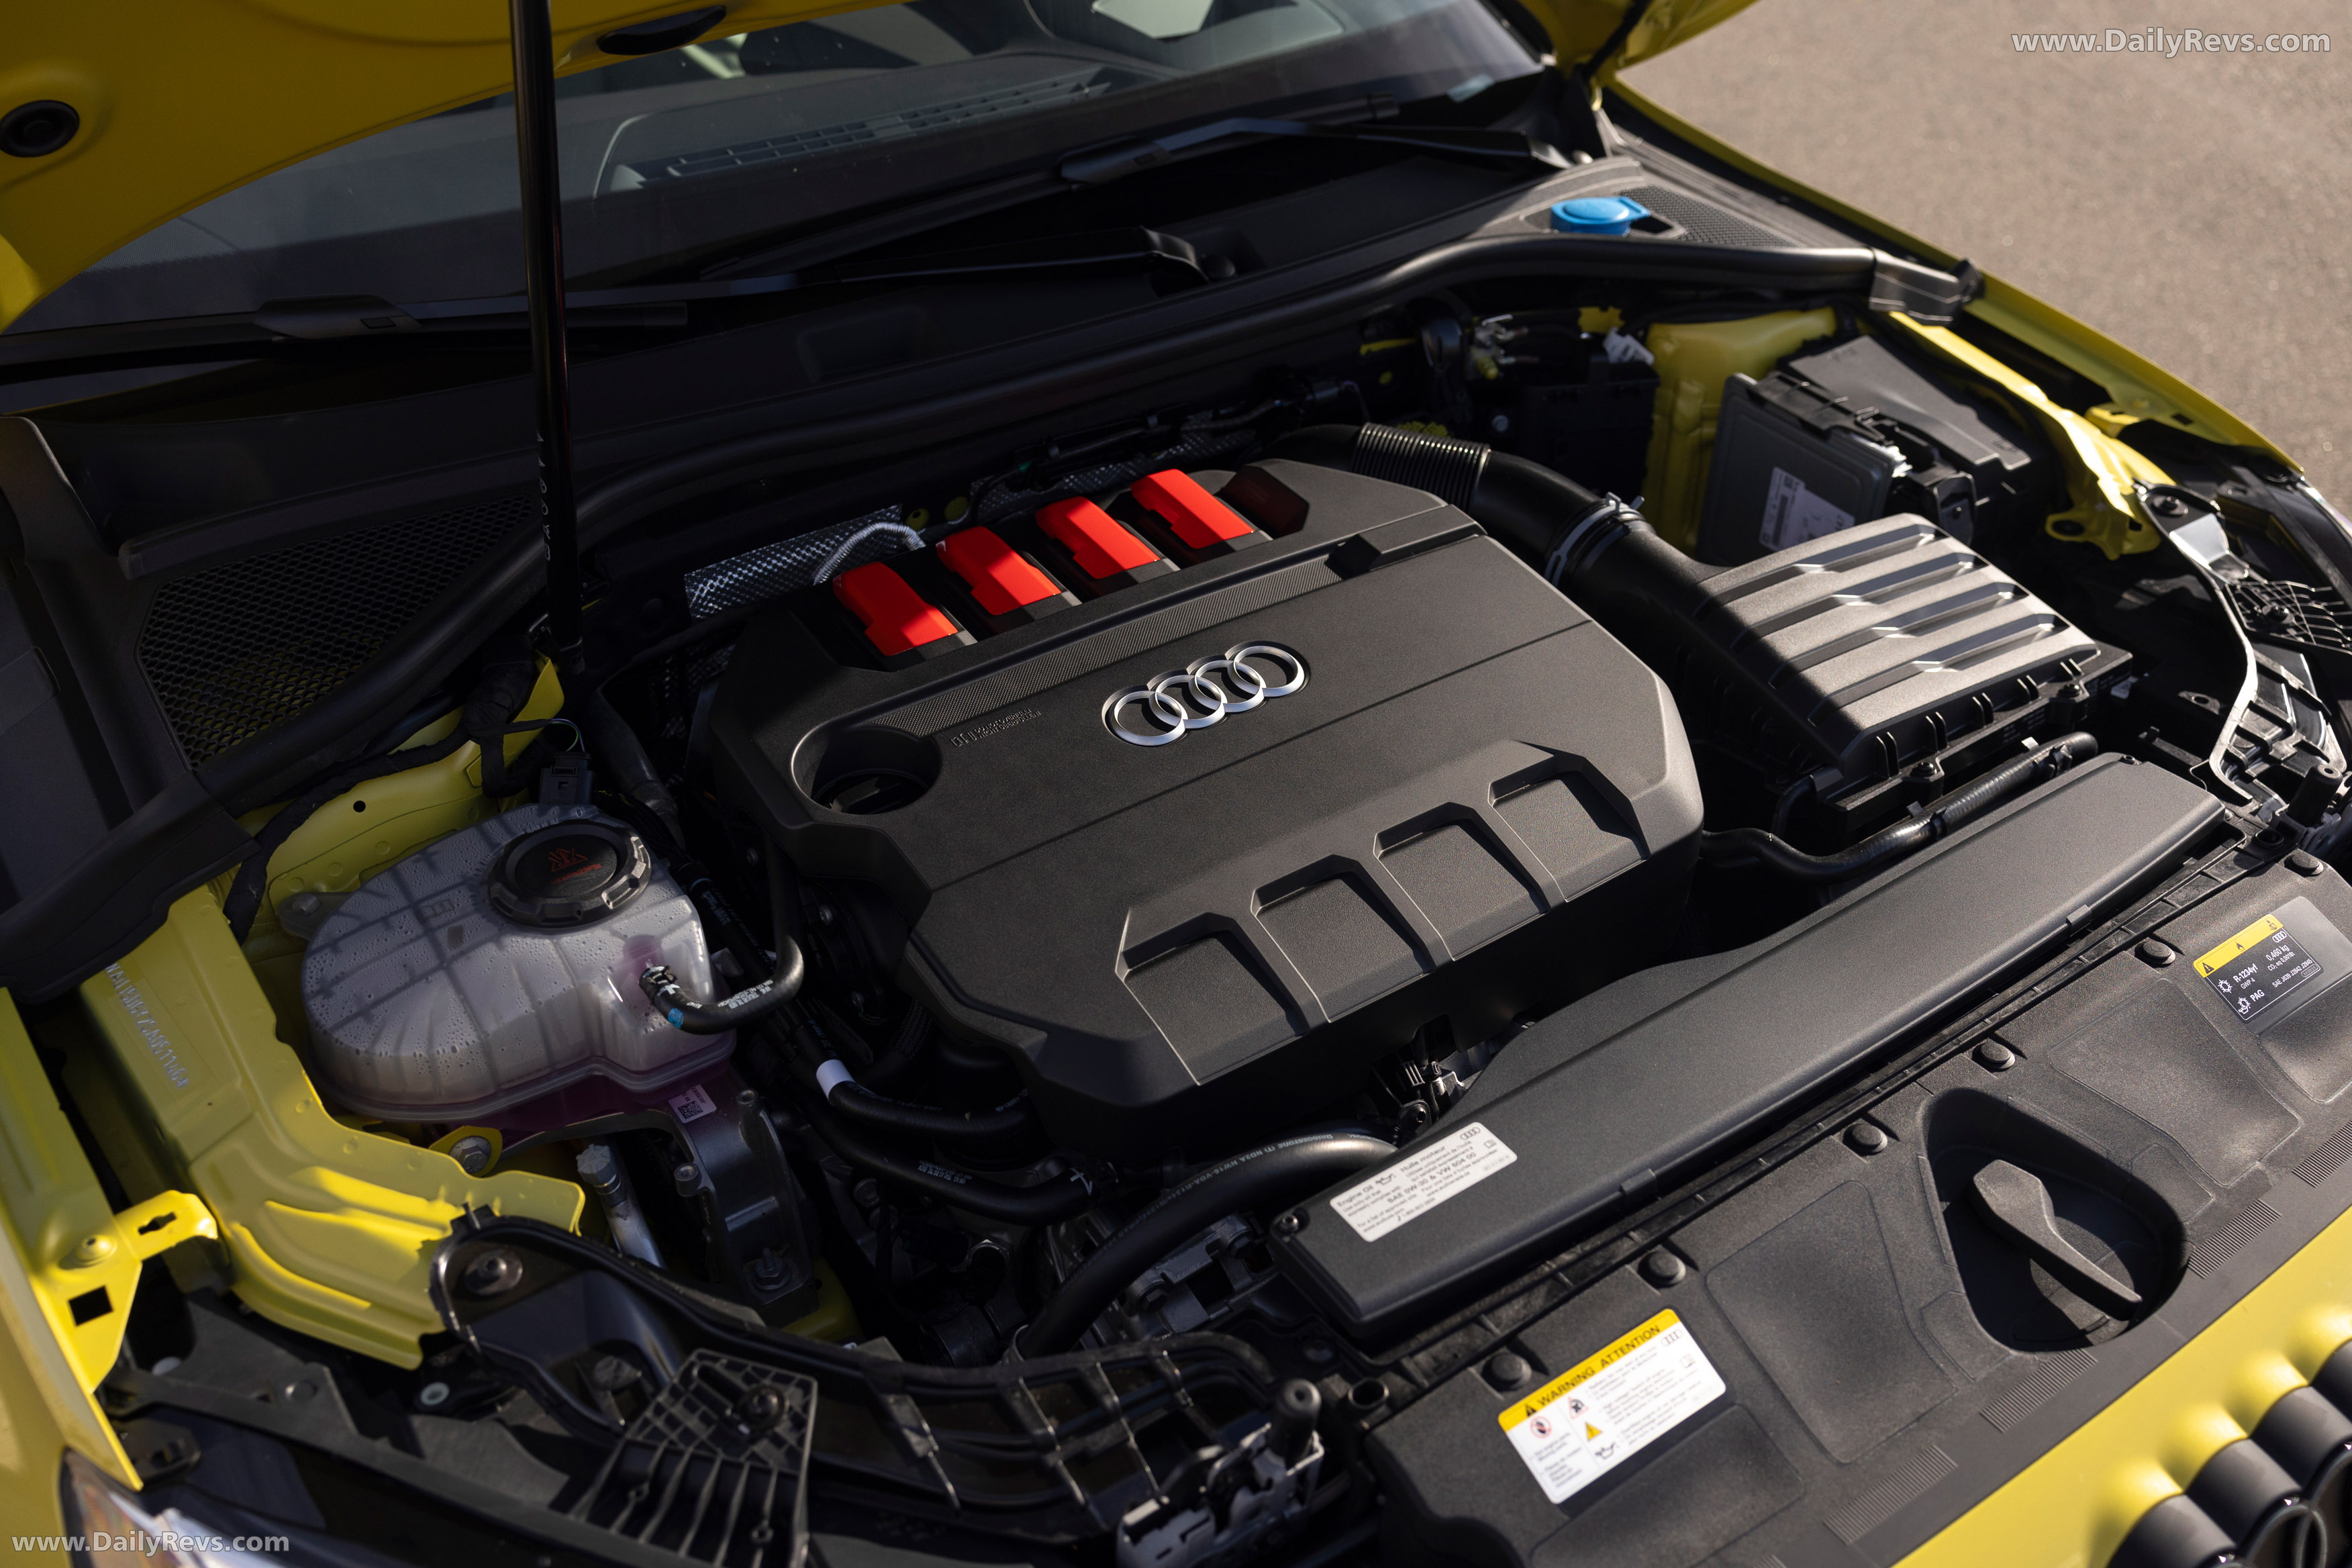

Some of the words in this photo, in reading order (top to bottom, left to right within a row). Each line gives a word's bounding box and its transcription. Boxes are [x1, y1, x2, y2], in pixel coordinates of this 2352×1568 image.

[2233, 963, 2259, 983] R-1234yf
[2265, 948, 2282, 961] 0,460
[2279, 944, 2290, 952] kg
[2240, 979, 2253, 989] GWP
[2249, 989, 2265, 1001] PAG
[2271, 979, 2282, 987] SAE
[2280, 972, 2292, 982] J639
[1277, 1134, 1334, 1150] BRIDGESTONE
[1336, 1190, 1364, 1208] Engine
[1361, 1183, 1375, 1193] Oil
[1399, 1159, 1420, 1172] Huile
[1418, 1145, 1446, 1162] moteur
[1385, 1191, 1404, 1204] SAE
[1435, 1165, 1452, 1175] VW
[1464, 1150, 1477, 1160] 00
[1536, 1365, 1596, 1408] WARNING
[1599, 1324, 1661, 1368] ATTENTION
